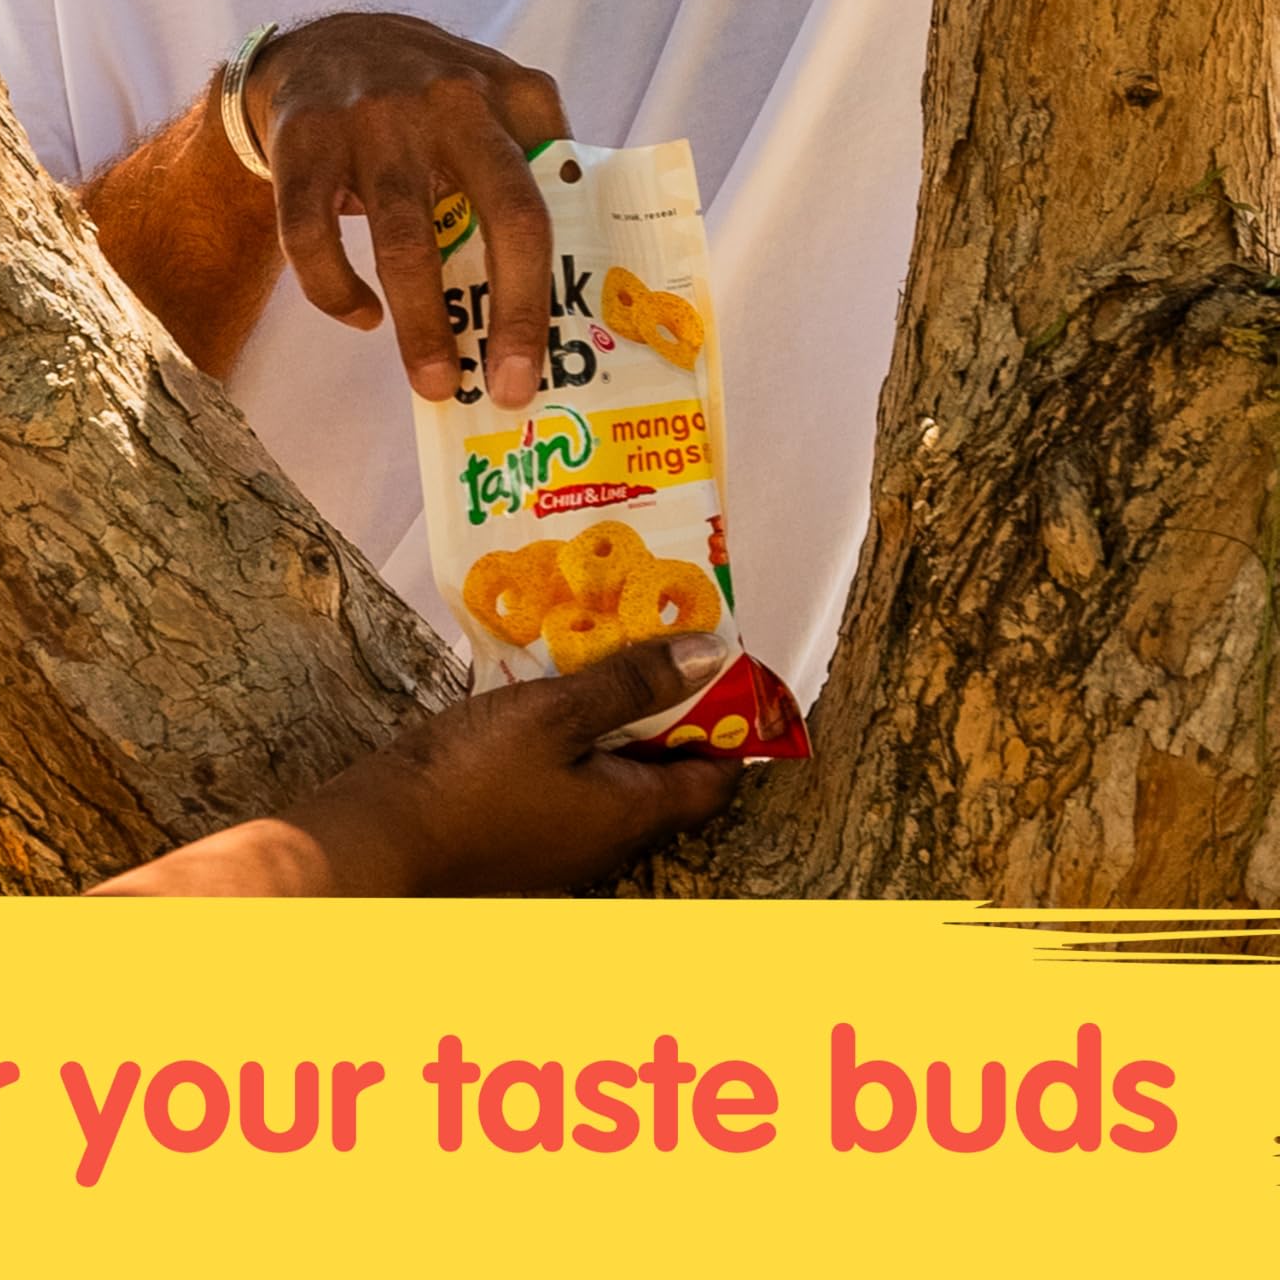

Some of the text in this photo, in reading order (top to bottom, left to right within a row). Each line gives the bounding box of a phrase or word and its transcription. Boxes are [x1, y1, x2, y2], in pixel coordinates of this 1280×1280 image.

[454, 325, 597, 405] cb
[612, 412, 706, 442] mango
[627, 444, 702, 475] rings
[584, 487, 599, 504] &
